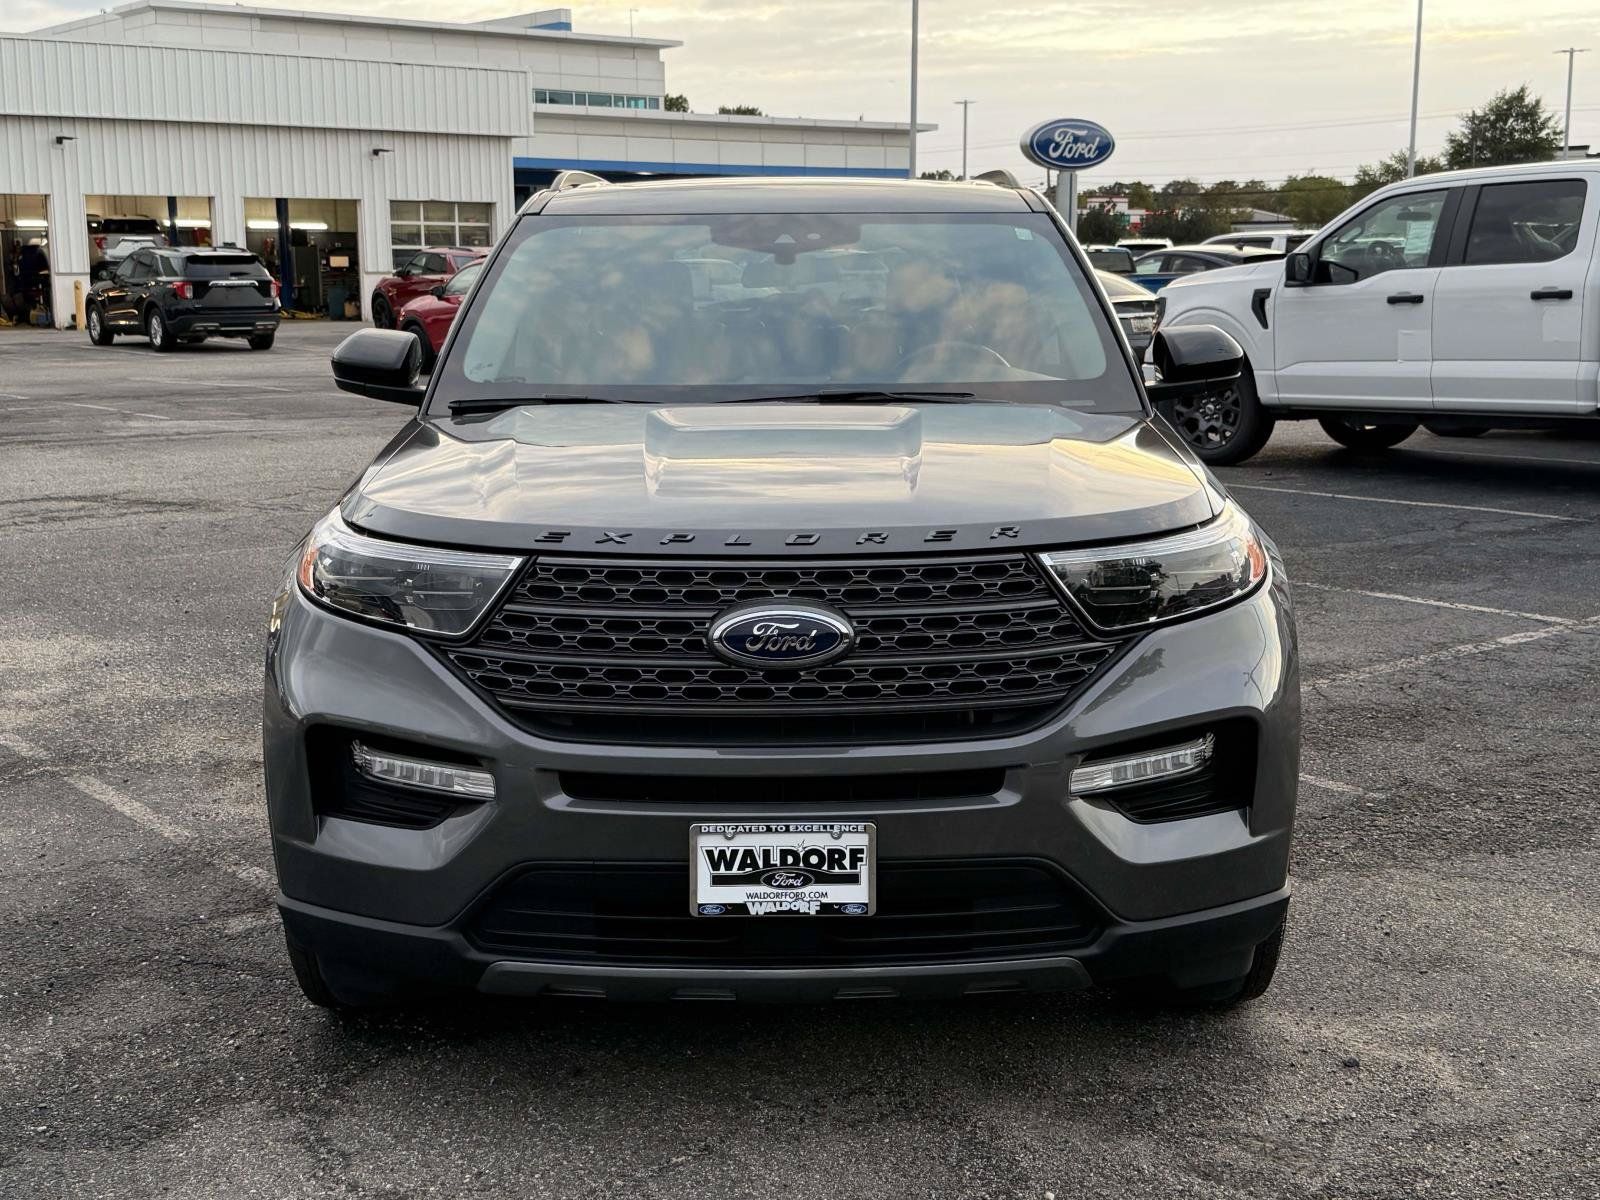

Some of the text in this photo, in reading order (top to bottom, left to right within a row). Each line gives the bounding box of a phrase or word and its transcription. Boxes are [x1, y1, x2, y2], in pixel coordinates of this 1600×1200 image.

[1048, 128, 1100, 159] Ford
[533, 524, 1022, 548] EXPLORER
[745, 622, 819, 651] Ford
[701, 824, 865, 833] DEDICATED TO EXCELLENCE
[702, 847, 866, 873] WALDORF
[771, 872, 804, 887] Ford
[745, 891, 829, 900] WALDORFFORD.COM
[745, 900, 821, 915] WALDORF
